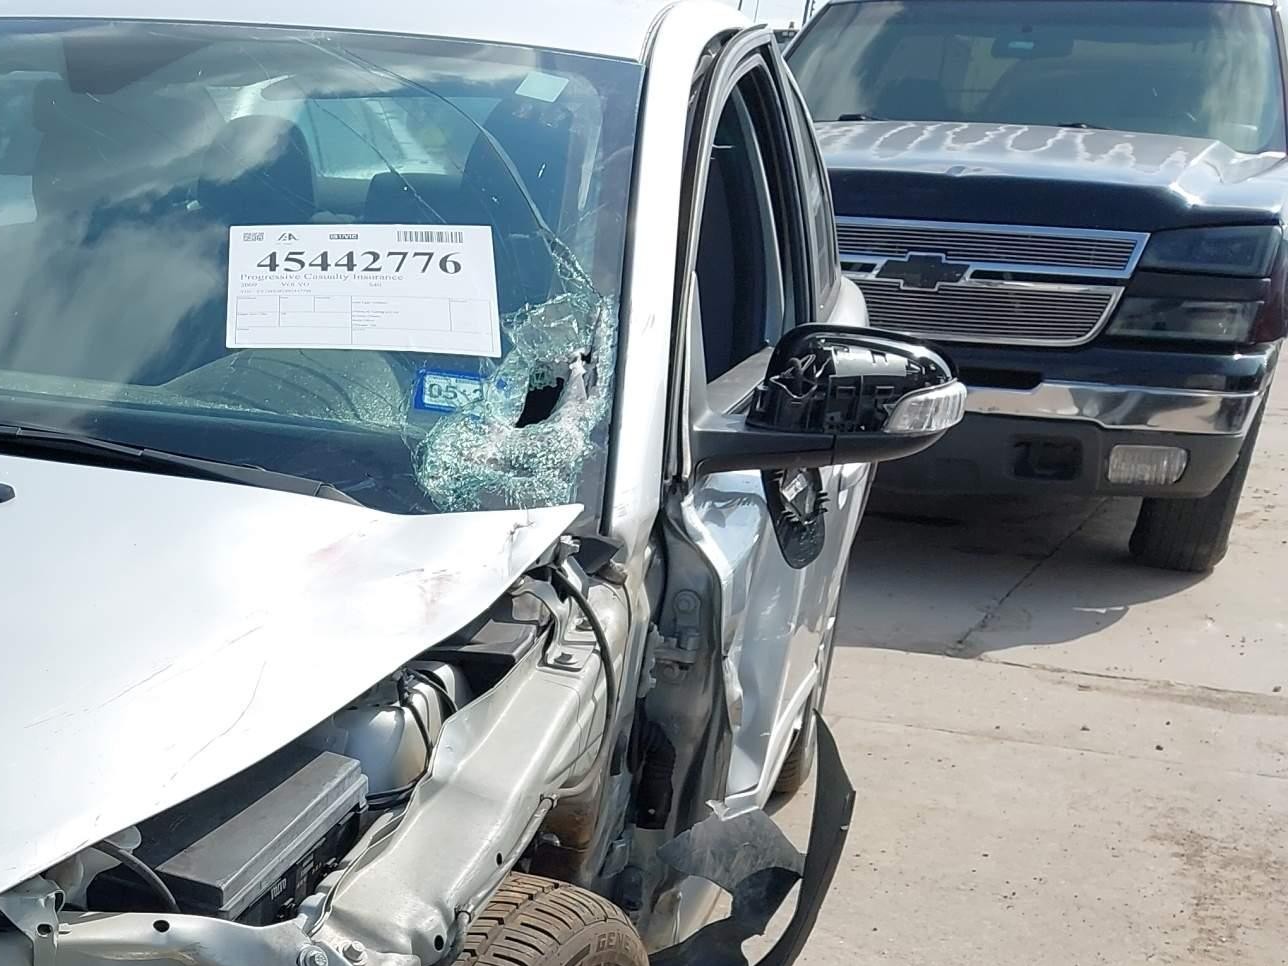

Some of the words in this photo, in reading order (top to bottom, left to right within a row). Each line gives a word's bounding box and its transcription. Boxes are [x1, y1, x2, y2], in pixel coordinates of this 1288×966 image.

[256, 250, 462, 274] 45442776
[240, 273, 301, 282] Progressive
[303, 273, 350, 282] Casualty
[353, 273, 404, 281] Insurance
